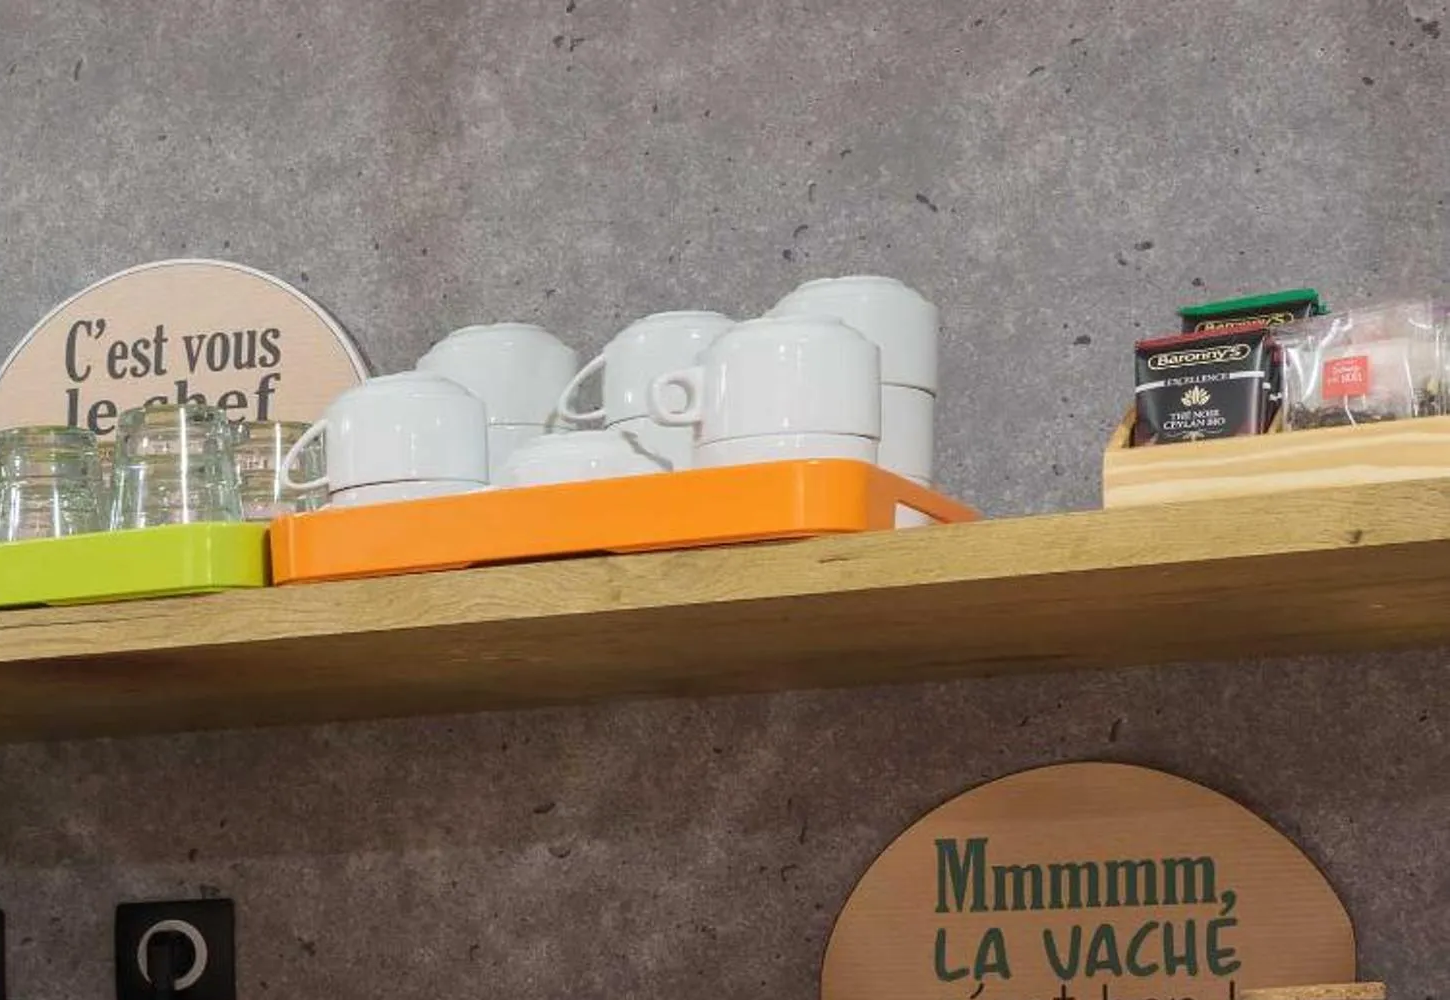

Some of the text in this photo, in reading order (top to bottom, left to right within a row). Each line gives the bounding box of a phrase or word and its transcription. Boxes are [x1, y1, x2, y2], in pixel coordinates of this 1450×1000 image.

[65, 318, 282, 384] C'est vous
[1166, 373, 1228, 387] EXCELLENCE
[65, 388, 118, 436] le
[934, 836, 1238, 918] Mmmmm,
[934, 916, 1243, 983] LA VACHE
